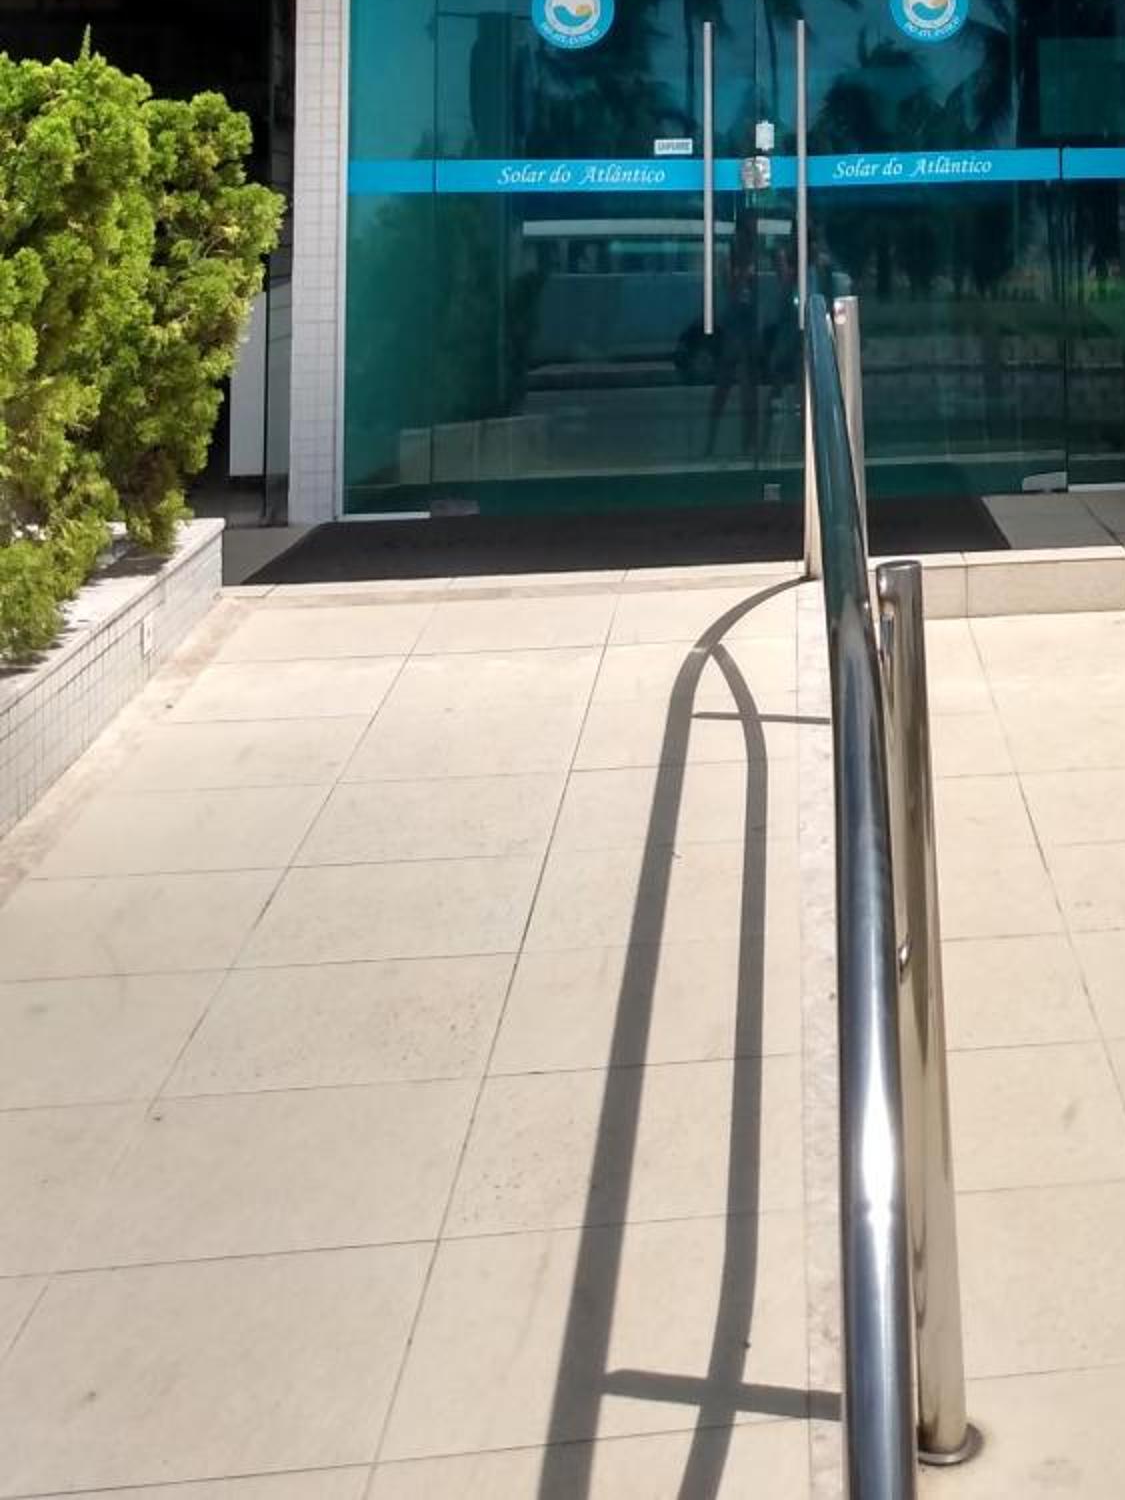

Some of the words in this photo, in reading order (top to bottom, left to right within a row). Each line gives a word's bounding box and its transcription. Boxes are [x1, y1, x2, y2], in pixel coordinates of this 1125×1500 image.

[496, 163, 545, 185] Solar
[549, 163, 571, 183] do
[578, 163, 666, 185] Atlântico
[832, 157, 880, 179] Solar
[882, 157, 903, 176] do
[909, 155, 993, 177] Atlântico
